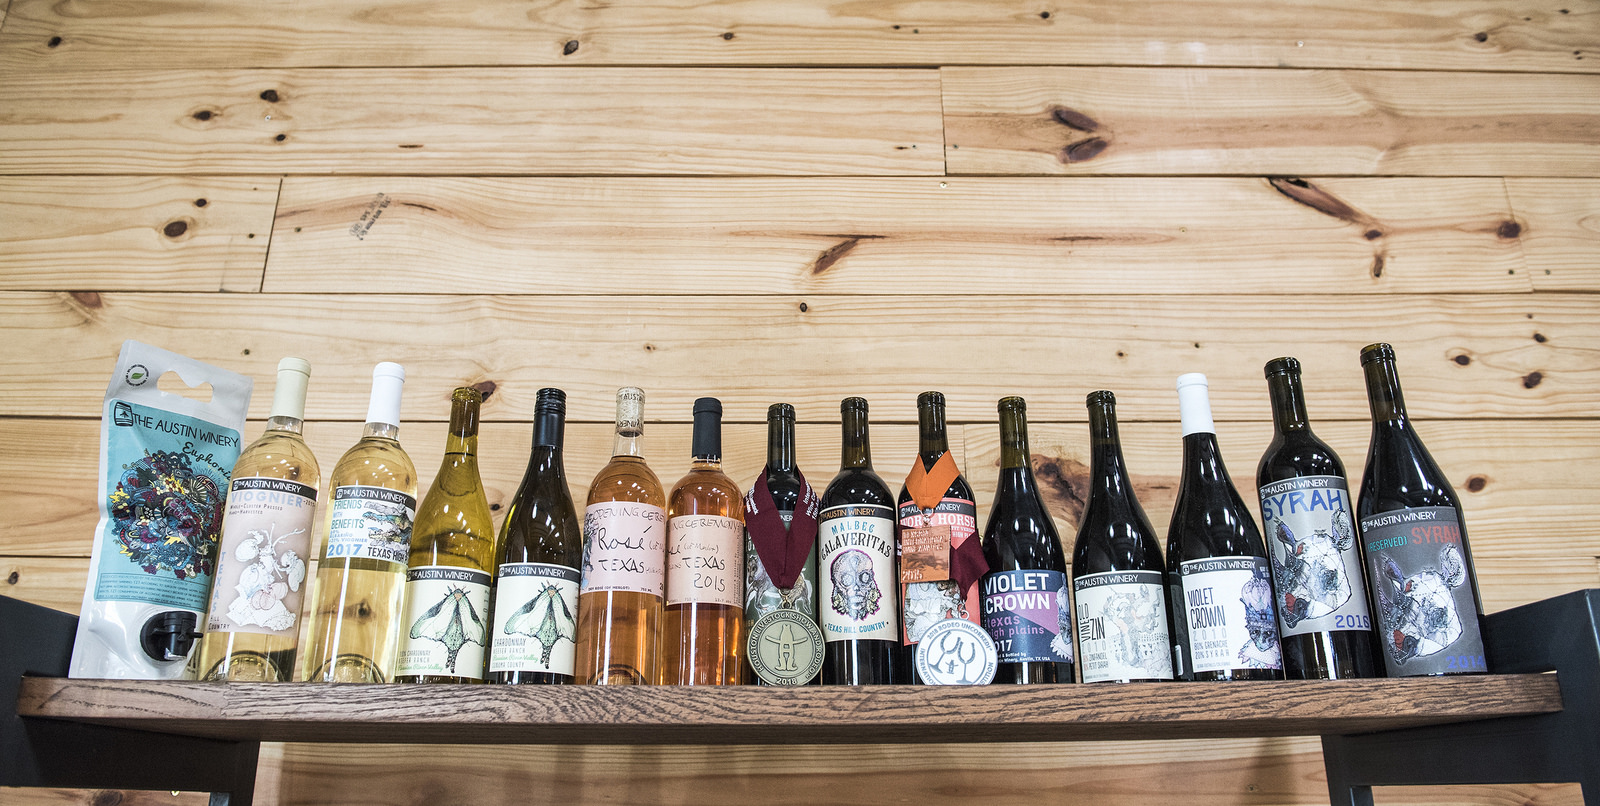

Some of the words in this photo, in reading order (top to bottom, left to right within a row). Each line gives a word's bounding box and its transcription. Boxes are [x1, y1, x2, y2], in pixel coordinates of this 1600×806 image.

[133, 413, 153, 429] THE
[155, 420, 198, 439] AUSTIN
[199, 428, 239, 448] WINERY
[244, 480, 272, 488] AUSTIN
[272, 482, 302, 493] WINERY
[1270, 482, 1298, 495] AUSTIN
[1299, 478, 1329, 489] WINERY
[232, 492, 302, 508] VIOGNIER
[350, 490, 379, 498] AUSTIN
[380, 492, 407, 504] WINERY
[334, 500, 362, 511] FRIENDS
[1262, 490, 1344, 521] SYRAH
[827, 510, 847, 519] AUSTIN
[848, 508, 876, 516] WINERY
[1374, 514, 1402, 528] AUSTIN
[1402, 511, 1437, 522] WINERY
[332, 519, 364, 530] BENEFITS
[831, 520, 876, 536] MALBEC
[938, 514, 975, 528] HORSE
[598, 526, 652, 551] Rosé
[1412, 525, 1460, 544] SYRAH
[328, 544, 362, 556] 2017
[368, 546, 392, 560] TEXAS
[821, 532, 892, 560] CALAVERITAS
[598, 558, 644, 574] TEXAS
[682, 556, 725, 570] TEXAS
[1198, 562, 1226, 572] AUSTIN
[1228, 561, 1256, 570] WINERY
[417, 570, 443, 579] AUSTIN
[444, 571, 474, 581] WINERY
[510, 566, 537, 575] AUSTIN
[538, 568, 566, 578] WINERY
[212, 551, 227, 613] TEXAS
[694, 573, 725, 592] 2015
[985, 573, 1050, 594] VIOLET
[1084, 577, 1108, 586] AUSTIN
[1108, 574, 1138, 584] WINERY
[986, 593, 1050, 614] CROWN
[1188, 587, 1214, 607] VIOLET
[756, 612, 791, 634] LIVESTOCK
[791, 612, 812, 630] SHOW
[987, 615, 1020, 628] texas
[1190, 605, 1226, 630] CROWN
[828, 622, 843, 633] TEXAS
[859, 620, 886, 633] COUNTRY
[927, 628, 938, 640] 2018
[938, 622, 960, 631] RODEO
[1009, 625, 1044, 638] plains
[1080, 618, 1092, 642] VINE
[1090, 616, 1106, 640] ZIN
[1194, 628, 1228, 642] 2010
[494, 638, 526, 647] CHARDONNAY
[996, 640, 1012, 652] 017
[1082, 640, 1106, 654] 2010
[1204, 640, 1228, 650] GRENACHE
[524, 654, 538, 664] Valley
[750, 634, 764, 672] HOUSTON
[1206, 650, 1230, 658] SYRAH
[428, 663, 444, 672] Valley
[1446, 655, 1485, 669] 2014
[776, 678, 798, 686] 2018
